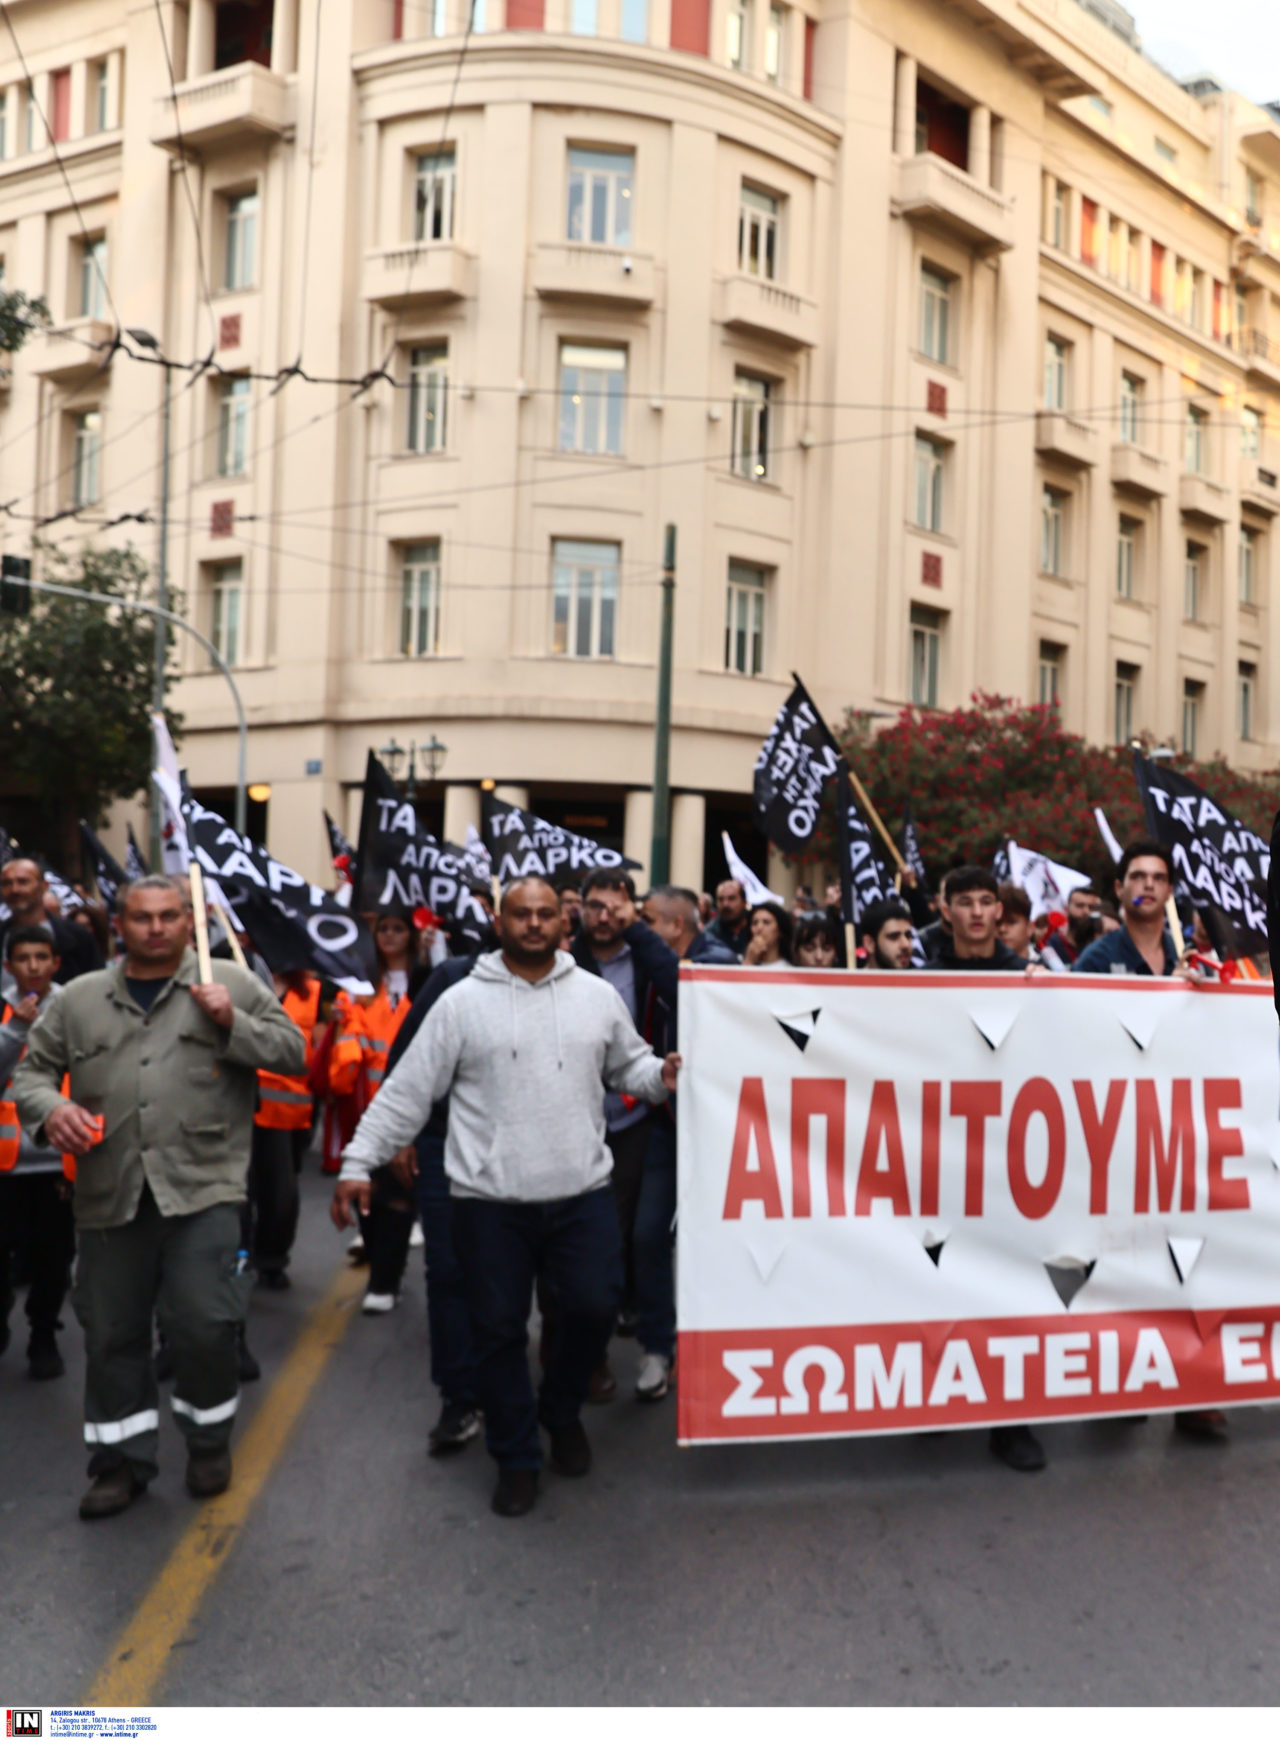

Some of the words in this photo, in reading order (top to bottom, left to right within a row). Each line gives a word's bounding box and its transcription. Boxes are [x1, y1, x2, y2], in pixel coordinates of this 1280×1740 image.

[376, 797, 417, 837] ΤΑ
[498, 847, 624, 882] ΛΑΡΚΟ
[1172, 842, 1269, 938] ΛΑΡΚ
[722, 1076, 1252, 1222] ΑΠΑΙΤΟΥΜΕ
[722, 1328, 1180, 1419] ΣΩΜΑΤΕΙΑ
